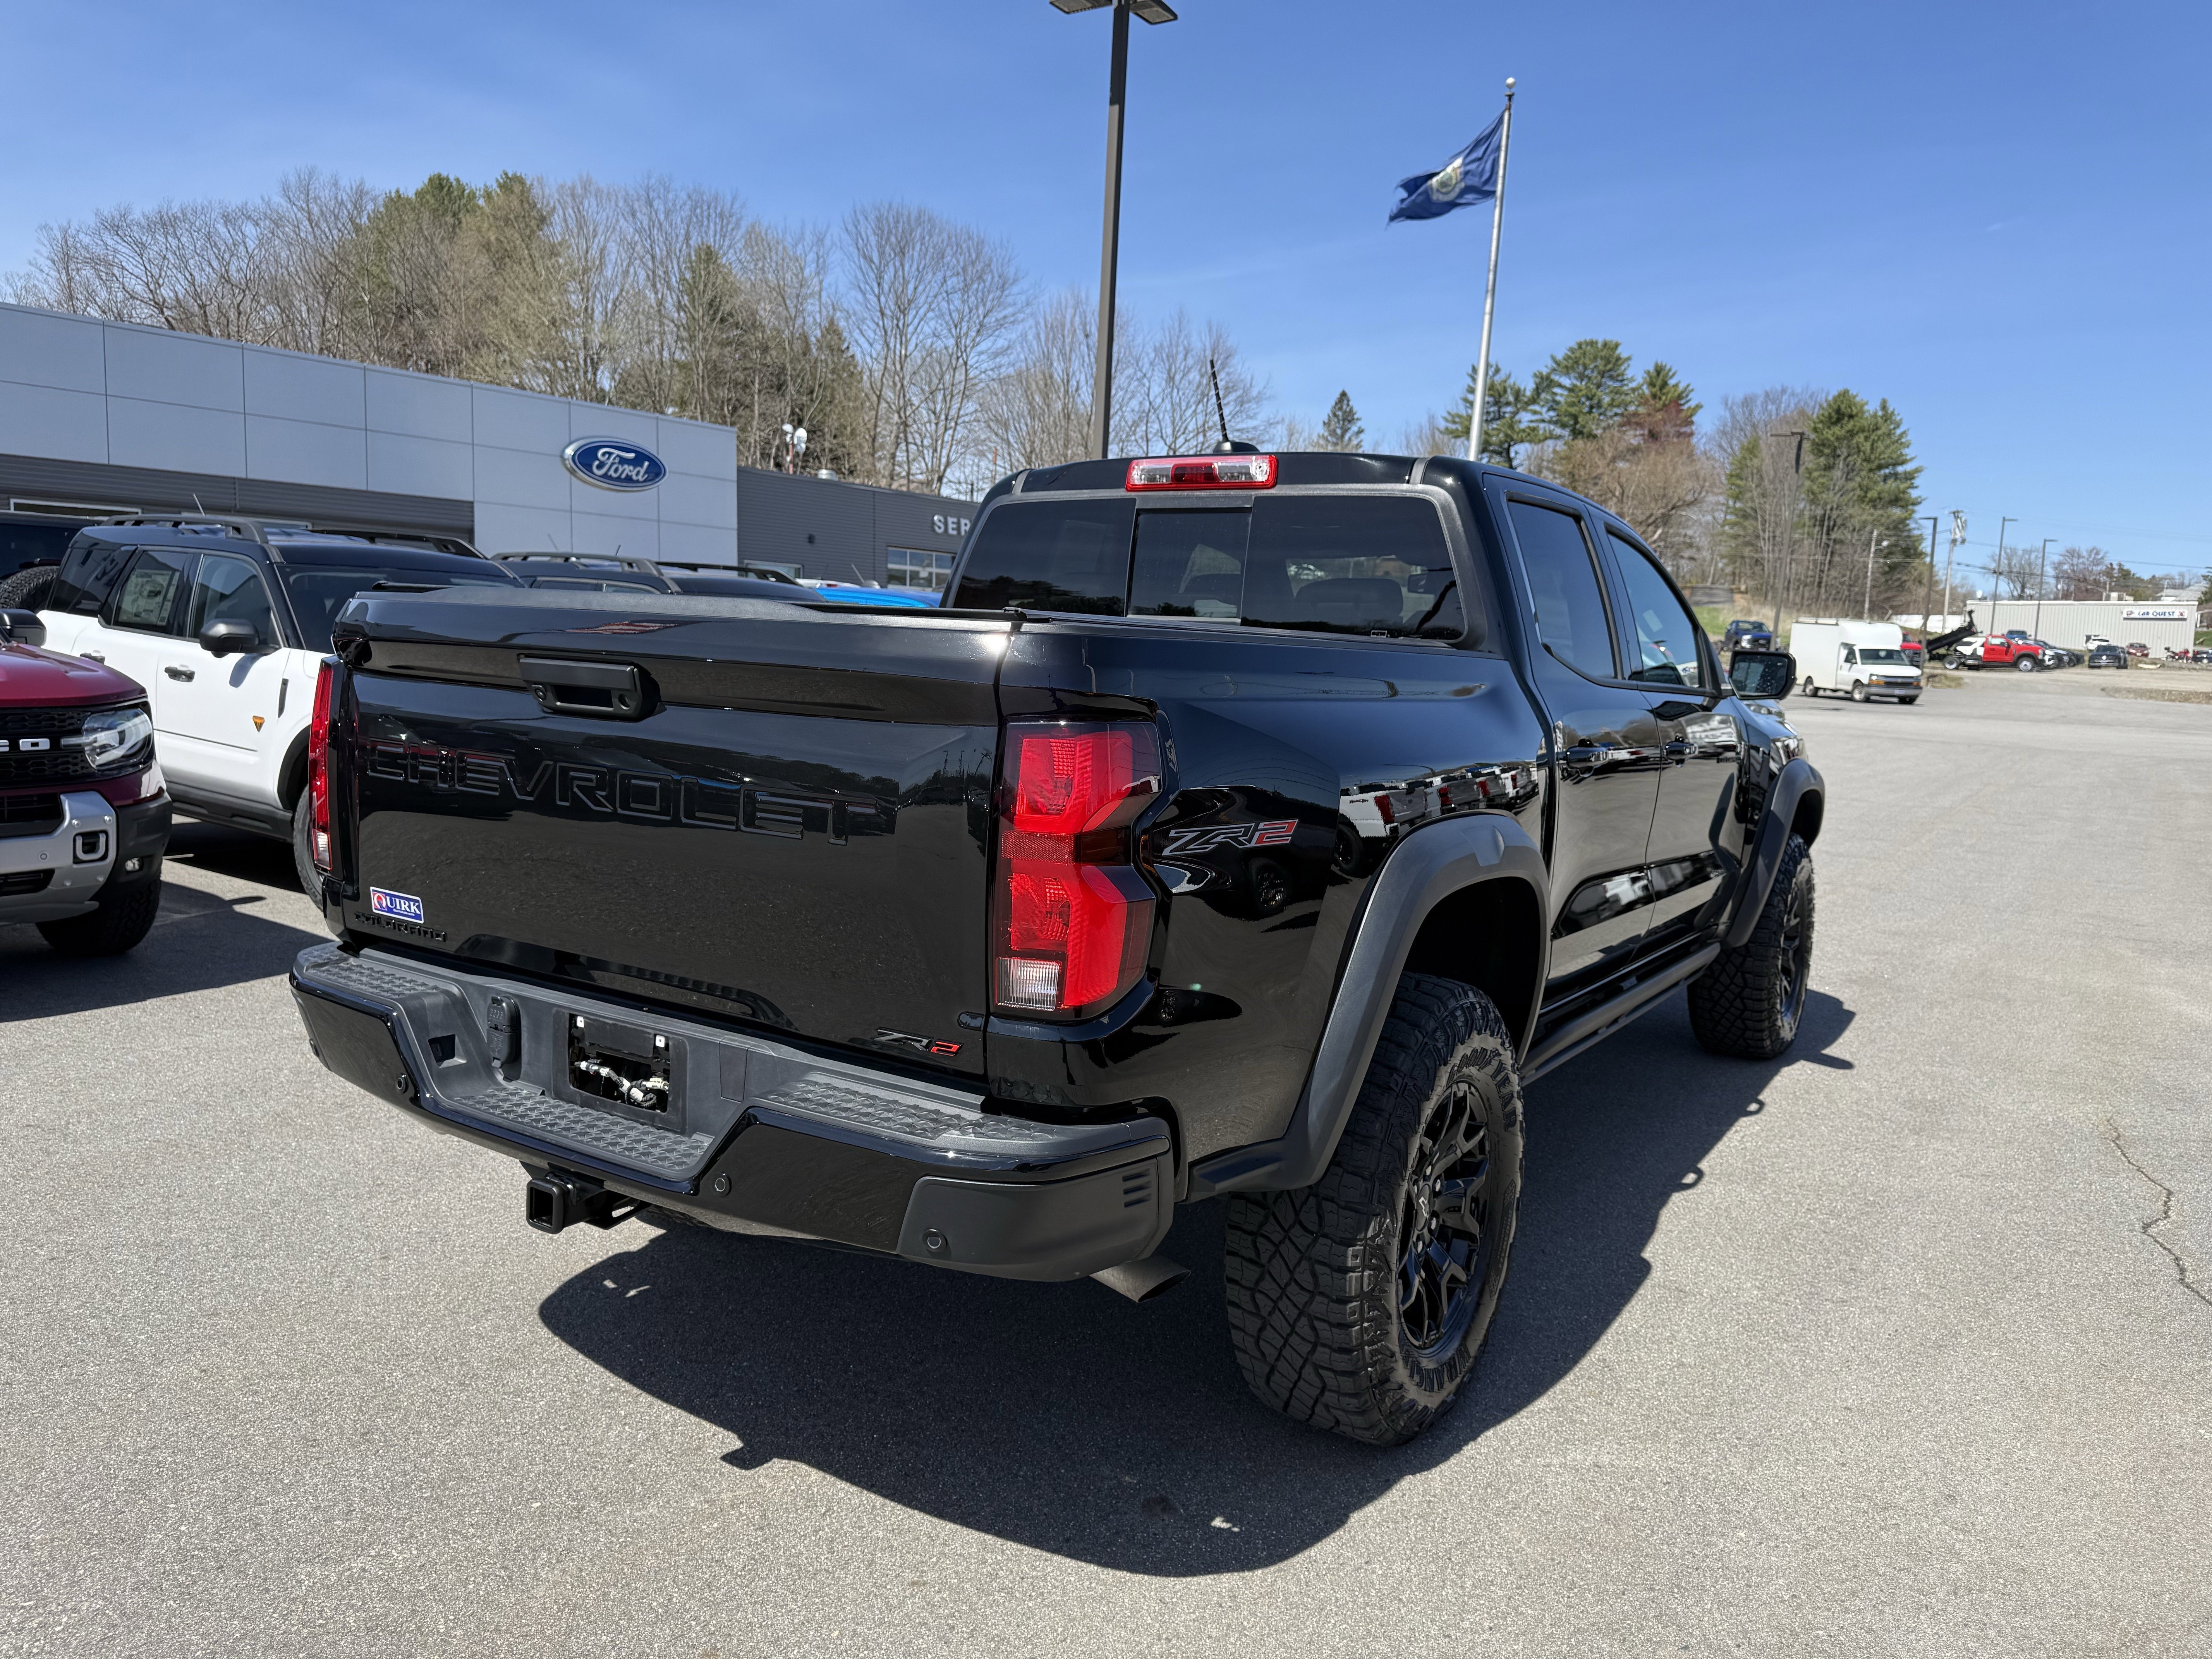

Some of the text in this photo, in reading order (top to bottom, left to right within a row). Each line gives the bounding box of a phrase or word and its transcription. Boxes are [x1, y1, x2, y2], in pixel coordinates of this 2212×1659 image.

[592, 448, 650, 481] Ford
[366, 737, 877, 845] CHEVROLET
[1162, 818, 1299, 856] ZR2
[374, 893, 421, 914] QUIRK
[873, 1027, 964, 1056] ZR2
